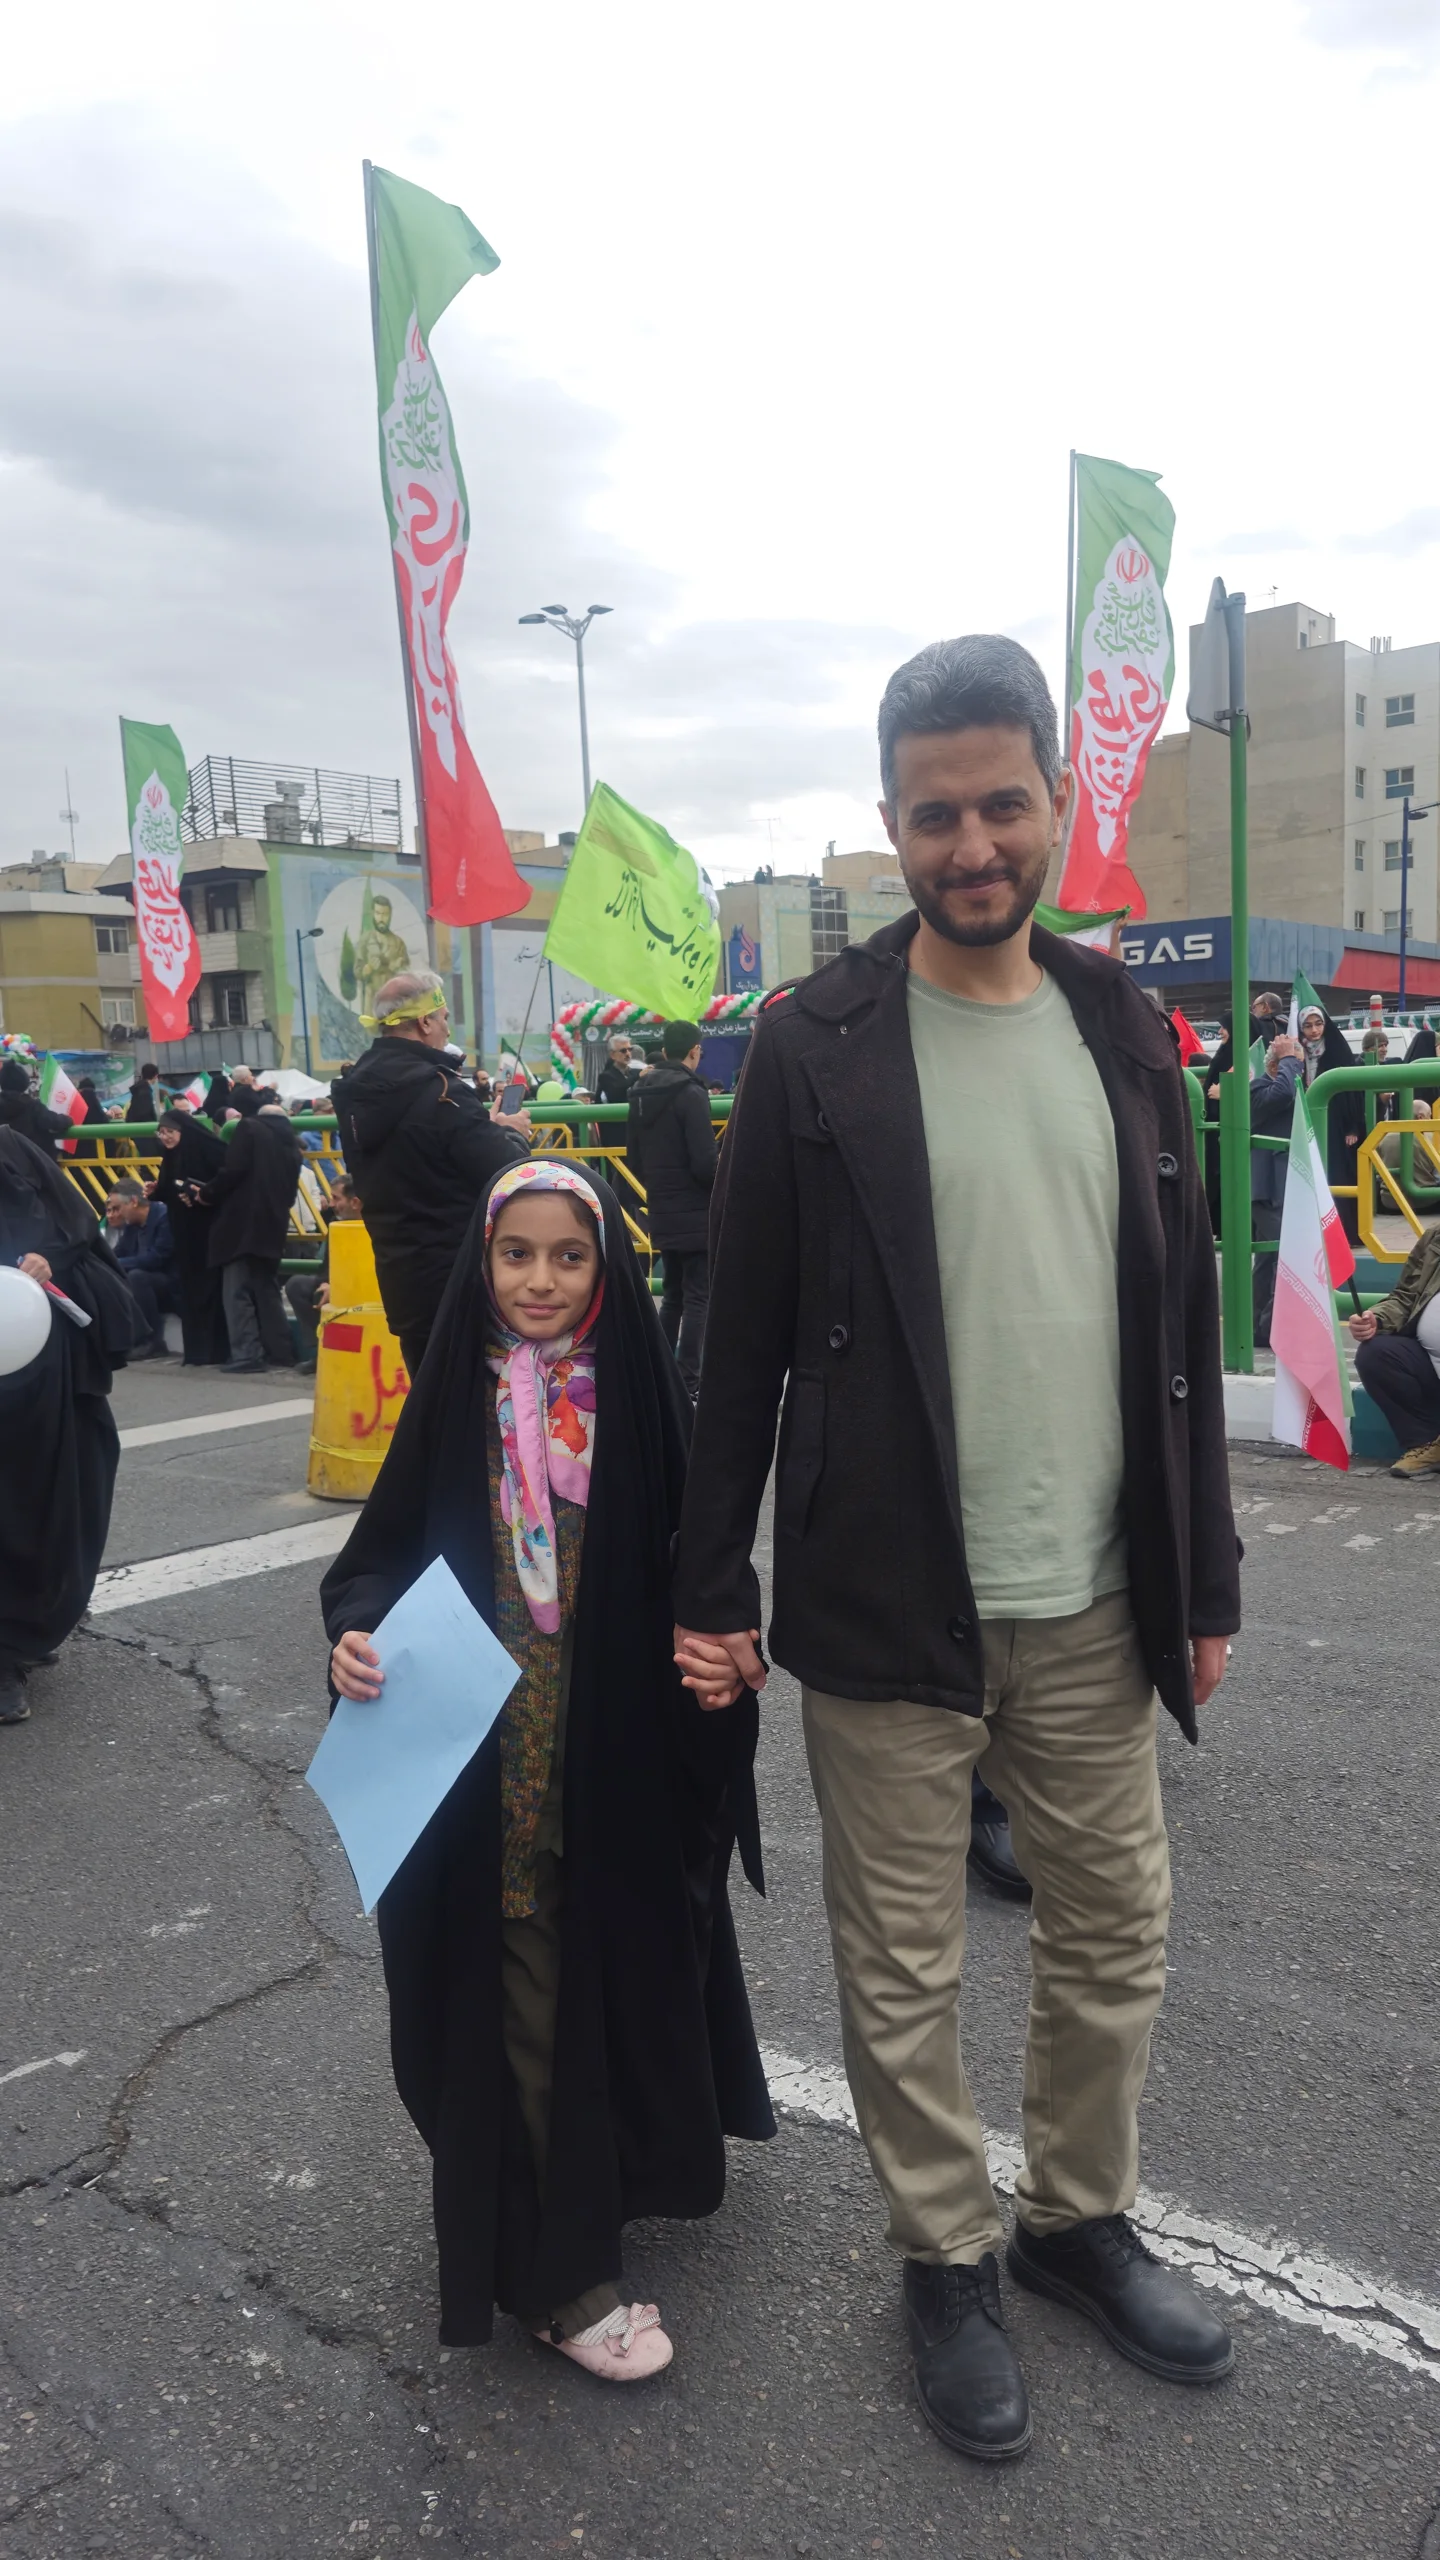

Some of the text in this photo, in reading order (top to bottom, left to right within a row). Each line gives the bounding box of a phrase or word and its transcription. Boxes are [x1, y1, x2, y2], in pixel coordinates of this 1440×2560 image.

[1120, 933, 1213, 967] GAS
[700, 1024, 716, 1036] بهدا
[717, 1023, 747, 1035] سازمان
